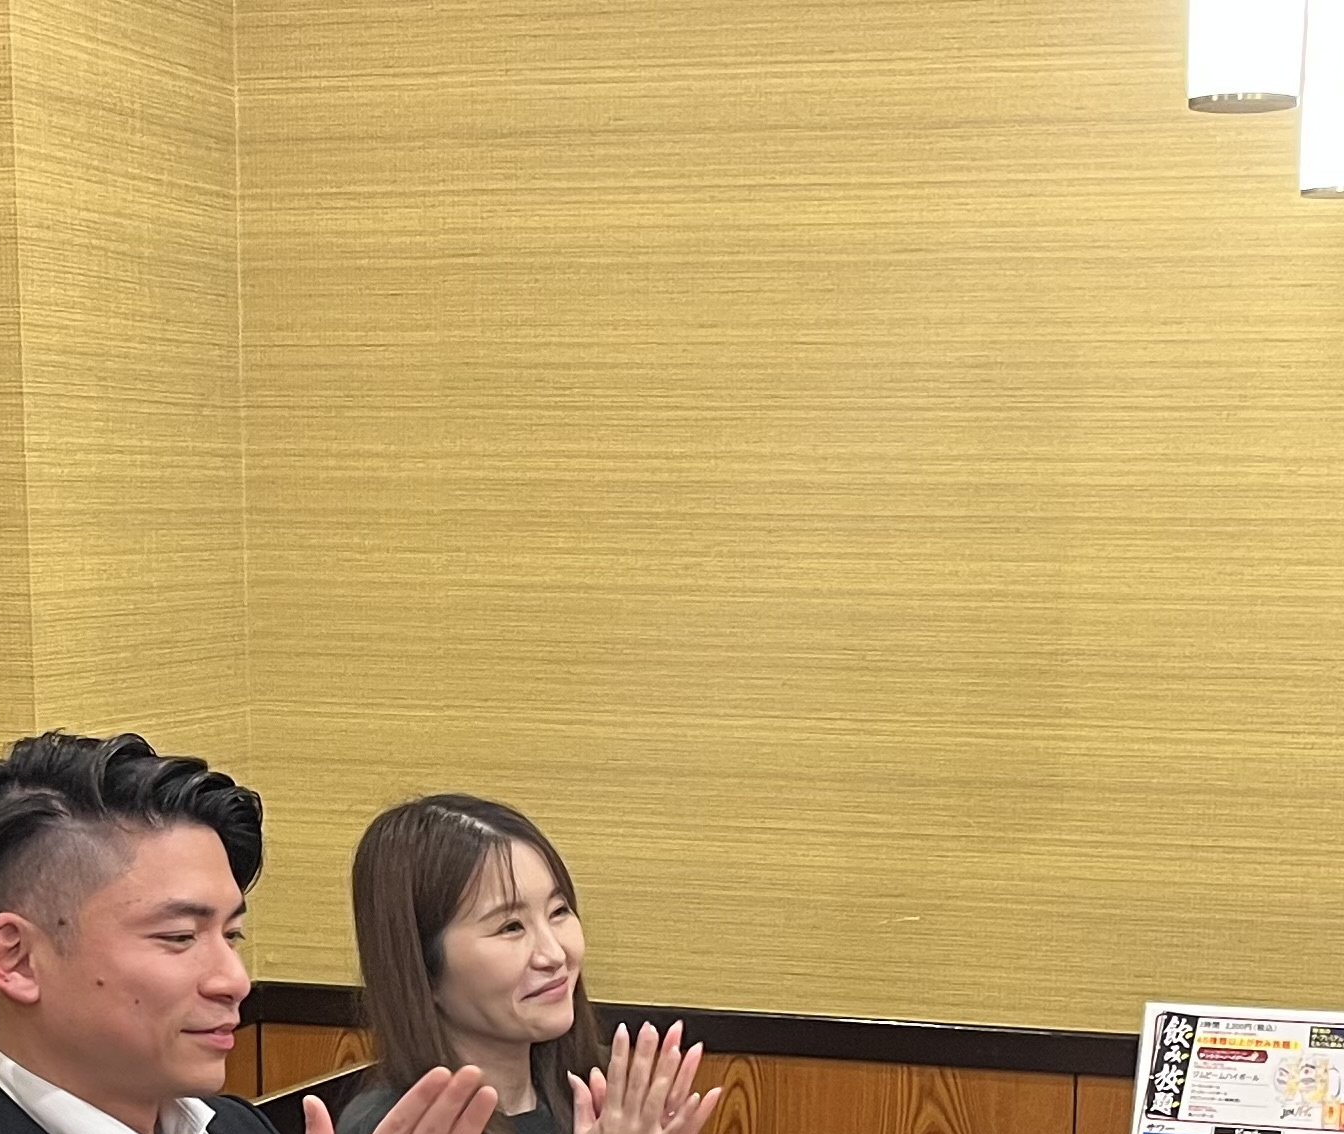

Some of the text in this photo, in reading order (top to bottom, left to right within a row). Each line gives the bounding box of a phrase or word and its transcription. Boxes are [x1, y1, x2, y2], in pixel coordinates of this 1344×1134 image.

[1149, 1015, 1194, 1116] 飲み放題
[1146, 1124, 1175, 1132] サワー
